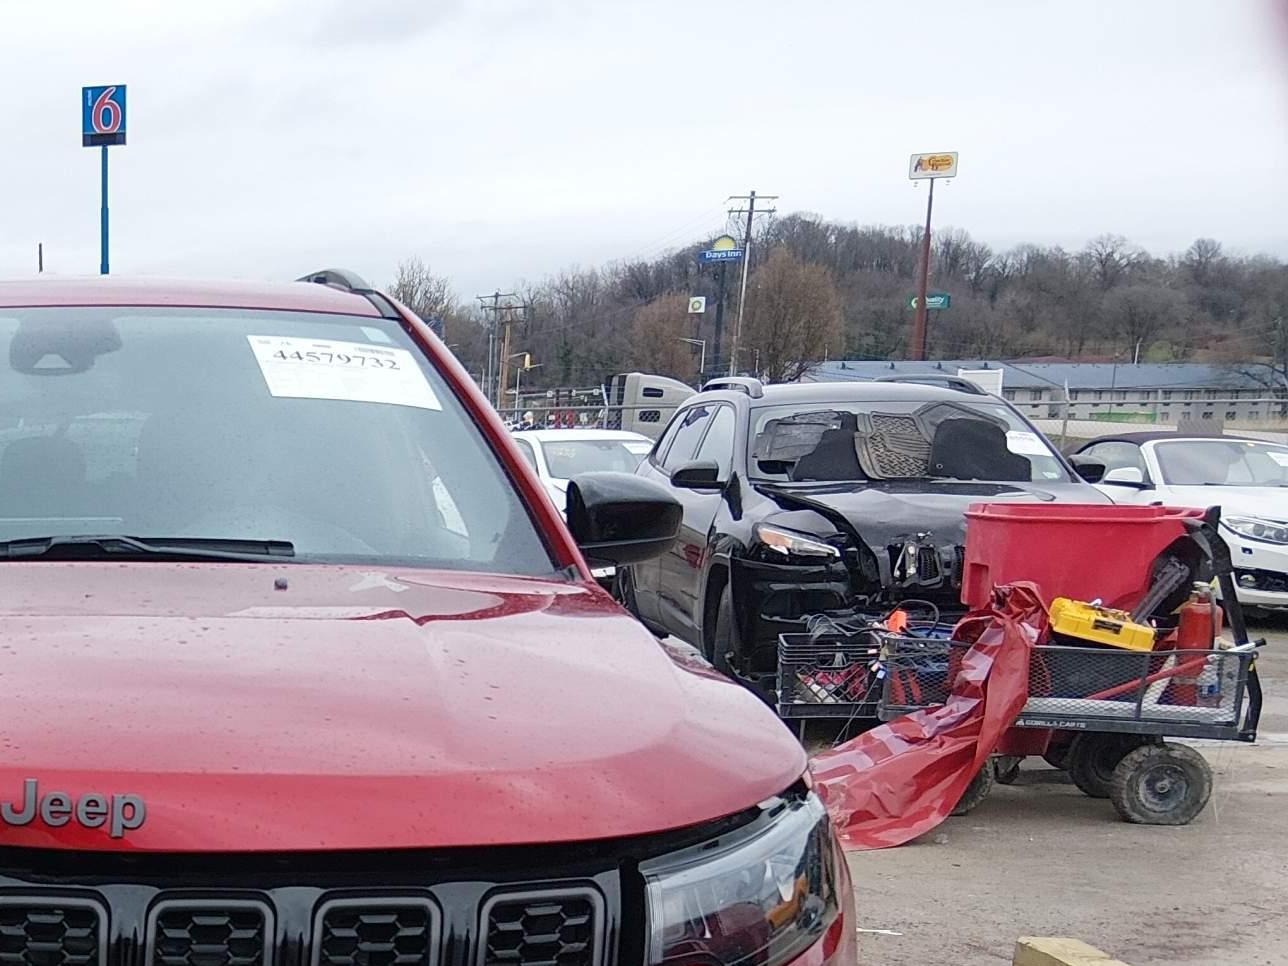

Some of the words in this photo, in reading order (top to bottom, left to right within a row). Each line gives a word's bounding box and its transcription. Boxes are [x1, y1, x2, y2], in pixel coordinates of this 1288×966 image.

[92, 86, 122, 133] 6
[705, 251, 726, 259] Days
[273, 349, 401, 371] 44579732
[0, 778, 146, 838] Jeep
